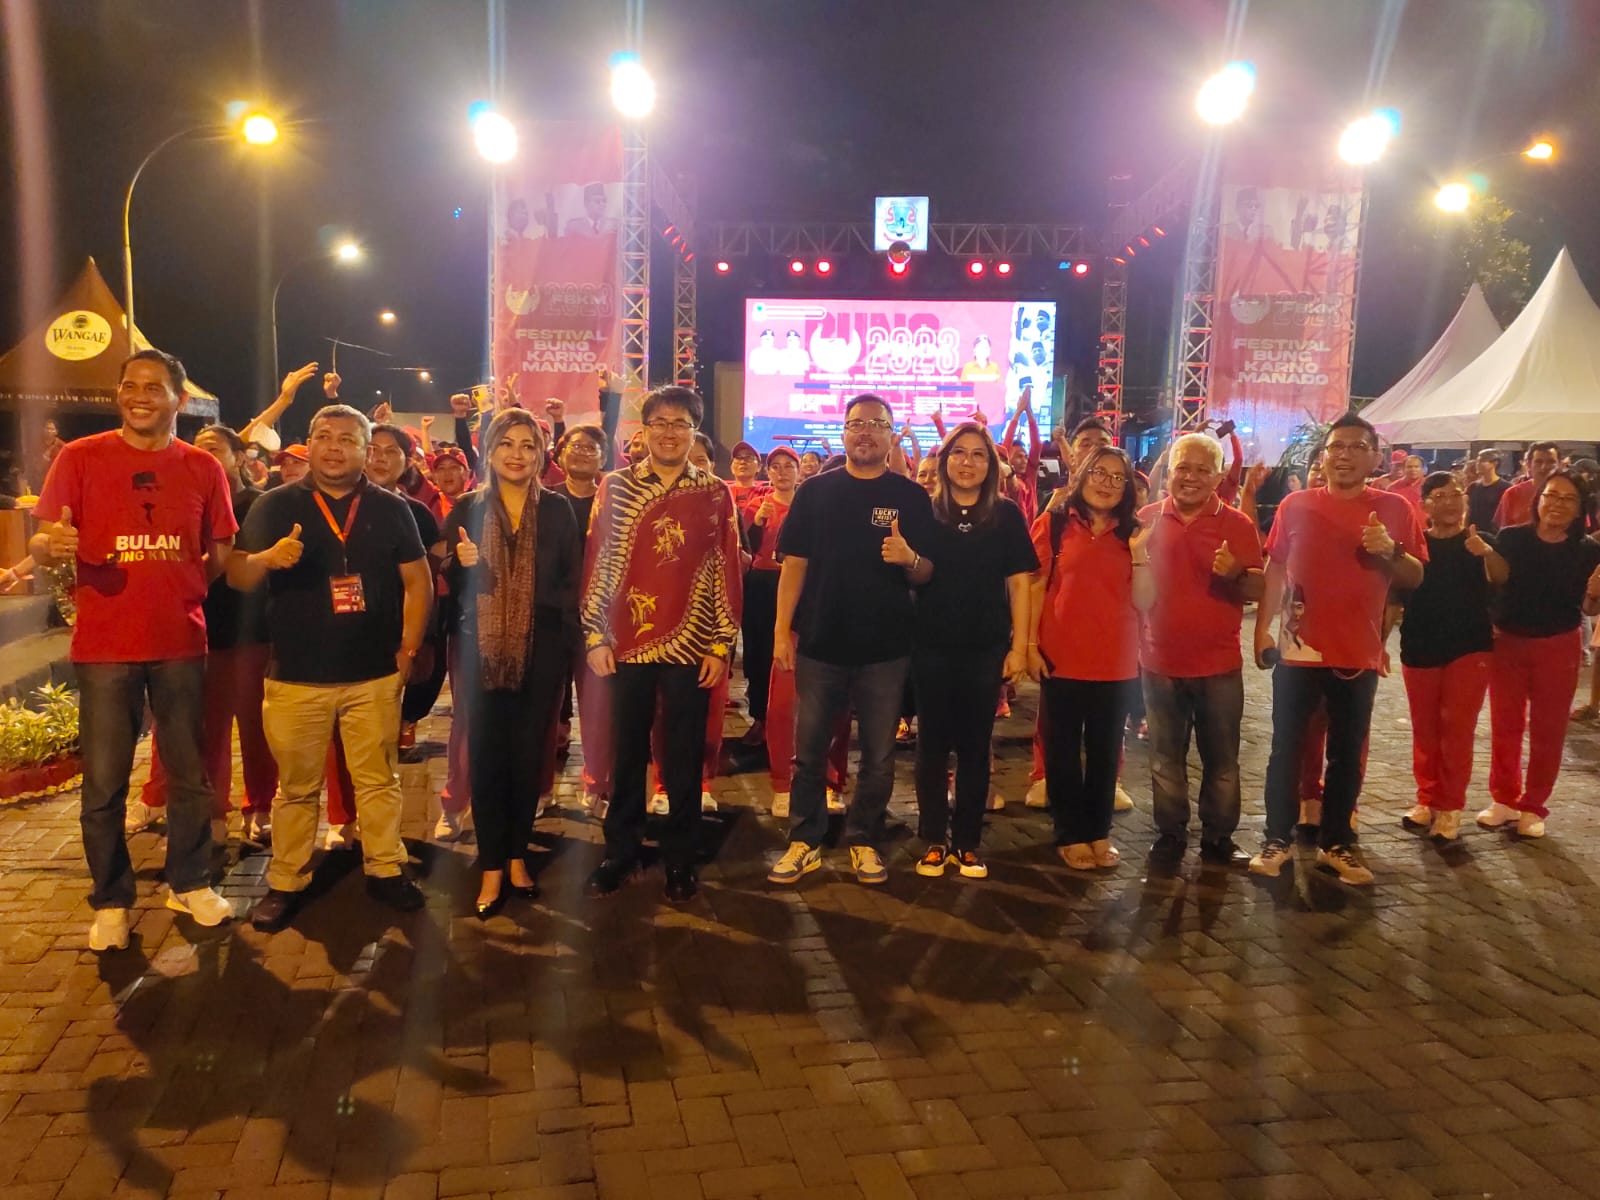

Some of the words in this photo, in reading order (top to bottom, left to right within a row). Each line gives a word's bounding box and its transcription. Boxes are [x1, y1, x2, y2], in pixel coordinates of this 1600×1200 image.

[53, 328, 106, 344] WANGAE
[515, 329, 607, 341] FESTIVAL
[533, 340, 590, 351] BUNG
[1233, 338, 1331, 352] FESTIVAL
[527, 350, 597, 362] KARNO
[1253, 350, 1313, 362] BUNG
[522, 361, 608, 373] MANADO
[1244, 360, 1319, 373] KARNO
[1238, 371, 1329, 385] MANADO
[116, 534, 181, 551] BULAN
